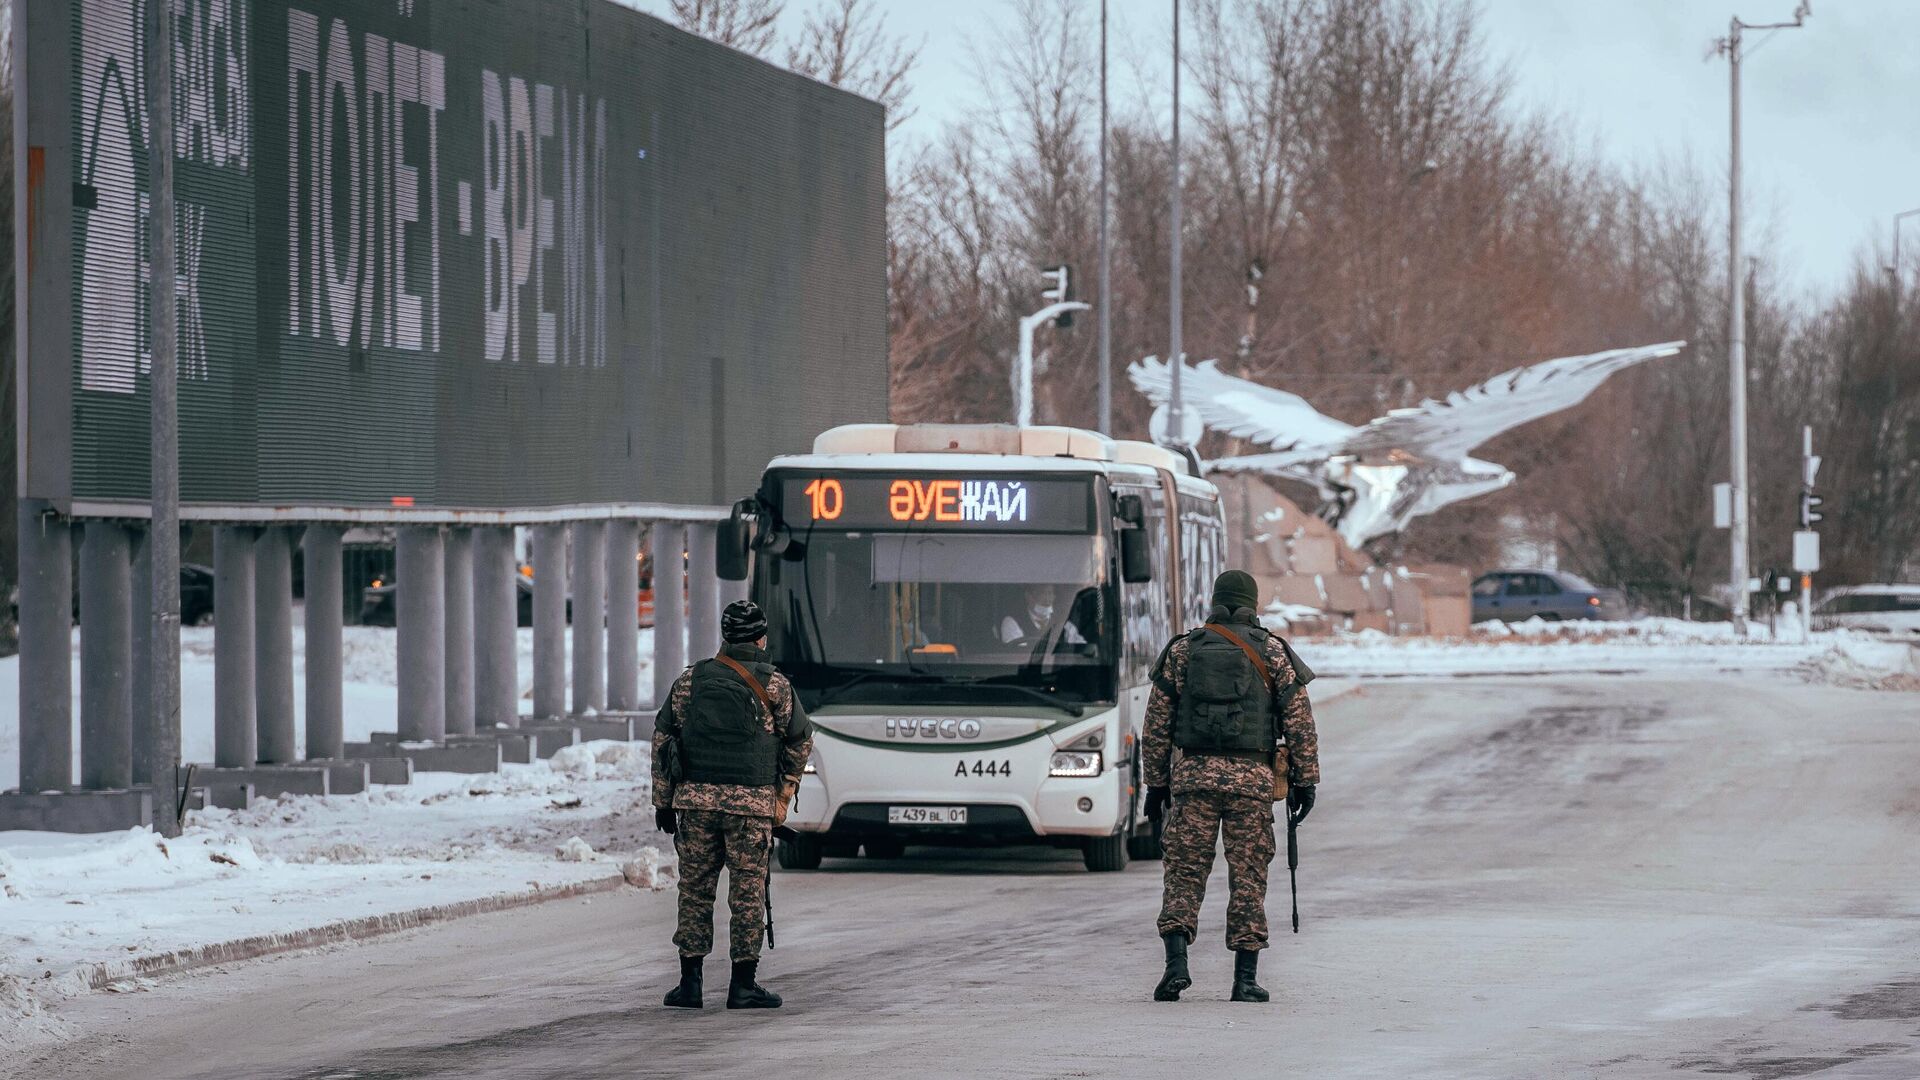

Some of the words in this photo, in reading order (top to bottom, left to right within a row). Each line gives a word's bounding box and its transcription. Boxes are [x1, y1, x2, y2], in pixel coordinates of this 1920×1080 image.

[288, 8, 446, 353] ПОЛЕТ
[804, 479, 844, 520] 10
[889, 480, 1027, 521] ӘУЕЖАЙ
[886, 718, 981, 739] IVECO
